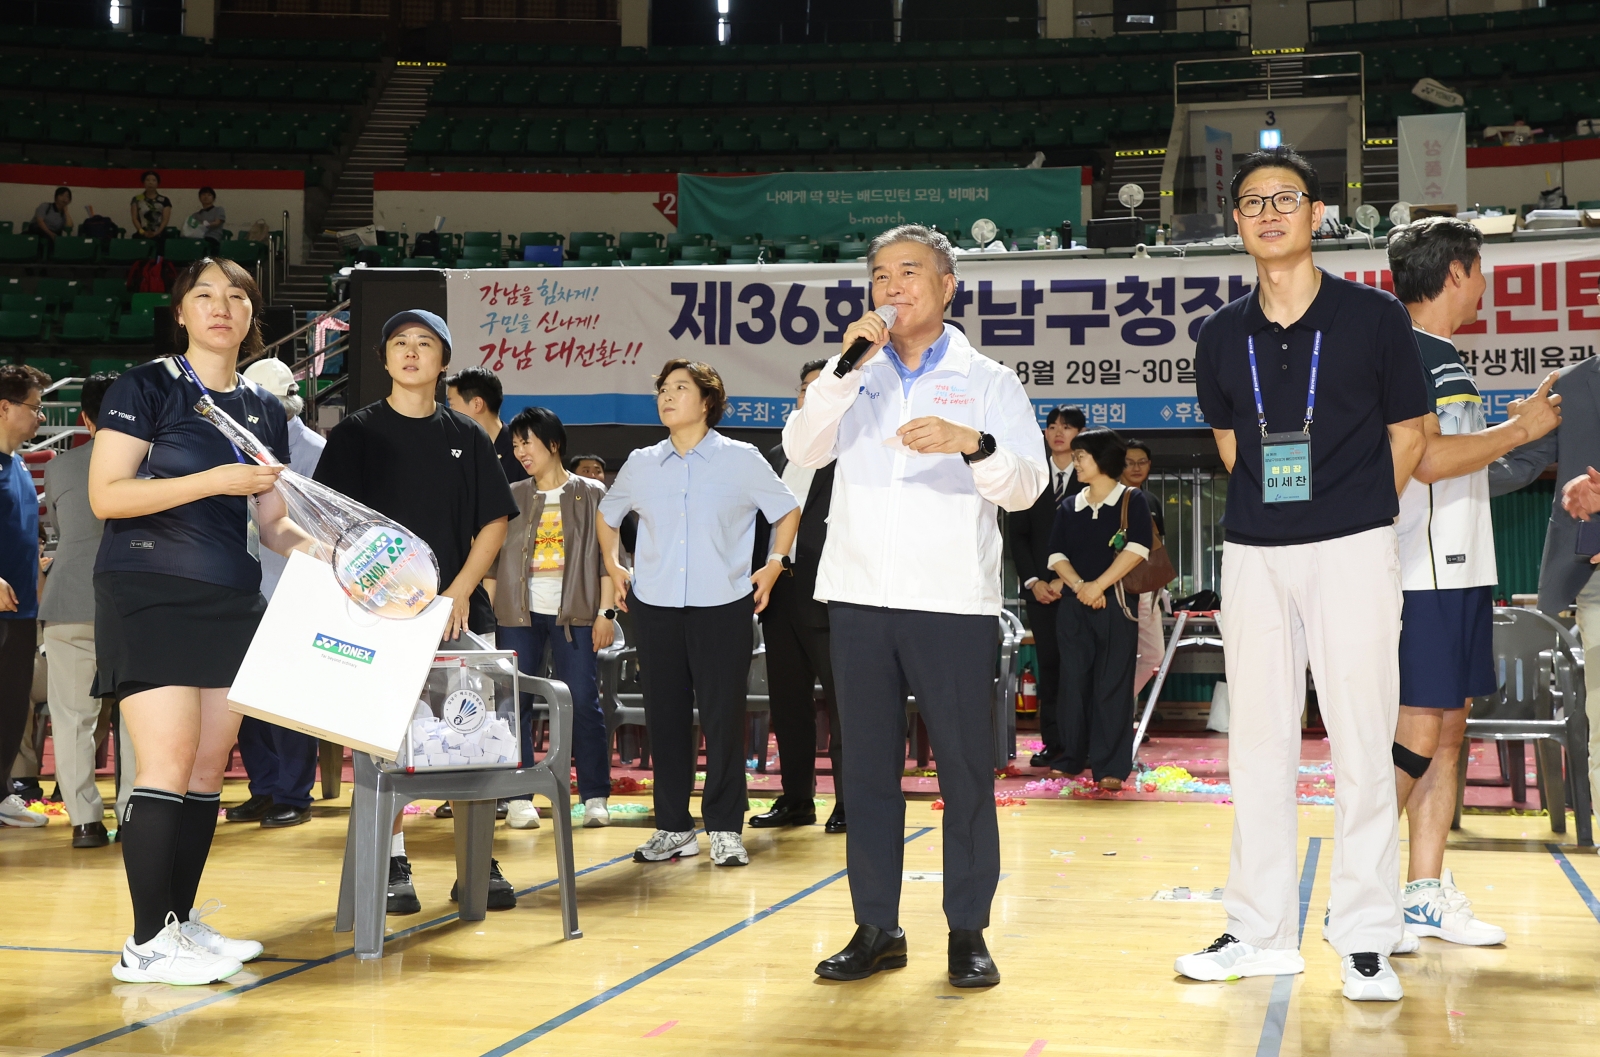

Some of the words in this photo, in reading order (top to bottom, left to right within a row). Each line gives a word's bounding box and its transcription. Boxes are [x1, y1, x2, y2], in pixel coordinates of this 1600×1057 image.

[1265, 110, 1276, 126] 3
[662, 192, 676, 215] 2
[766, 190, 807, 205] 나에게
[810, 190, 824, 204] 딱
[827, 189, 854, 204] 맞는
[857, 188, 911, 203] 배드민턴
[914, 188, 945, 204] 모임,
[948, 187, 990, 202] 비매치
[848, 210, 905, 225] b-match
[479, 281, 534, 307] 강남을
[537, 278, 599, 307] 힘차게!
[479, 311, 532, 337] 구민을
[536, 310, 600, 334] 신나게!
[668, 279, 873, 346] 제36회
[479, 337, 537, 372] 강남
[544, 336, 643, 369] 대전환!!
[1016, 359, 1055, 386] 8월
[1066, 357, 1197, 386] 29일~30일
[117, 411, 137, 422] YONEX
[736, 401, 776, 423] 주최:
[1267, 475, 1307, 488] 이세찬
[355, 561, 391, 593] YONEX
[337, 642, 372, 661] YONEX
